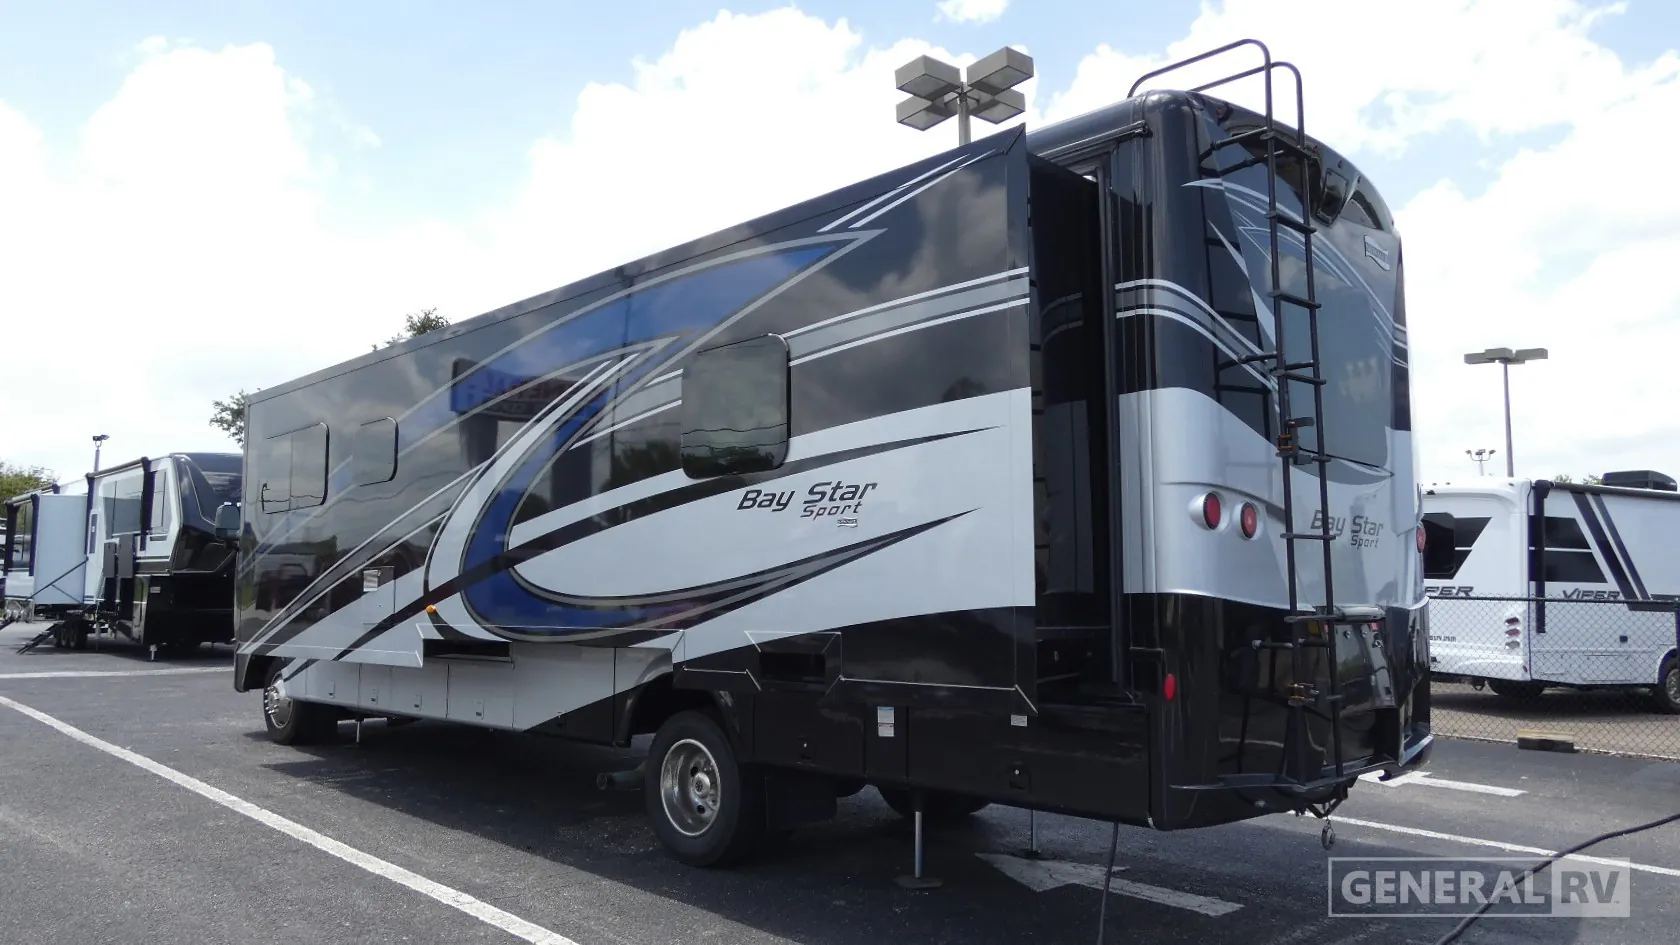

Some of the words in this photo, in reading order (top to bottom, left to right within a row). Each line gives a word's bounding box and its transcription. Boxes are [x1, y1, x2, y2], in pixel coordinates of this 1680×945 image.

[736, 489, 795, 512] Bay
[803, 480, 878, 504] Star
[800, 501, 862, 520] Sport
[1310, 509, 1346, 536] Bay
[1350, 514, 1384, 537] Star
[1350, 535, 1380, 550] Sport
[1424, 586, 1474, 598] PER
[1562, 588, 1621, 600] VIPER
